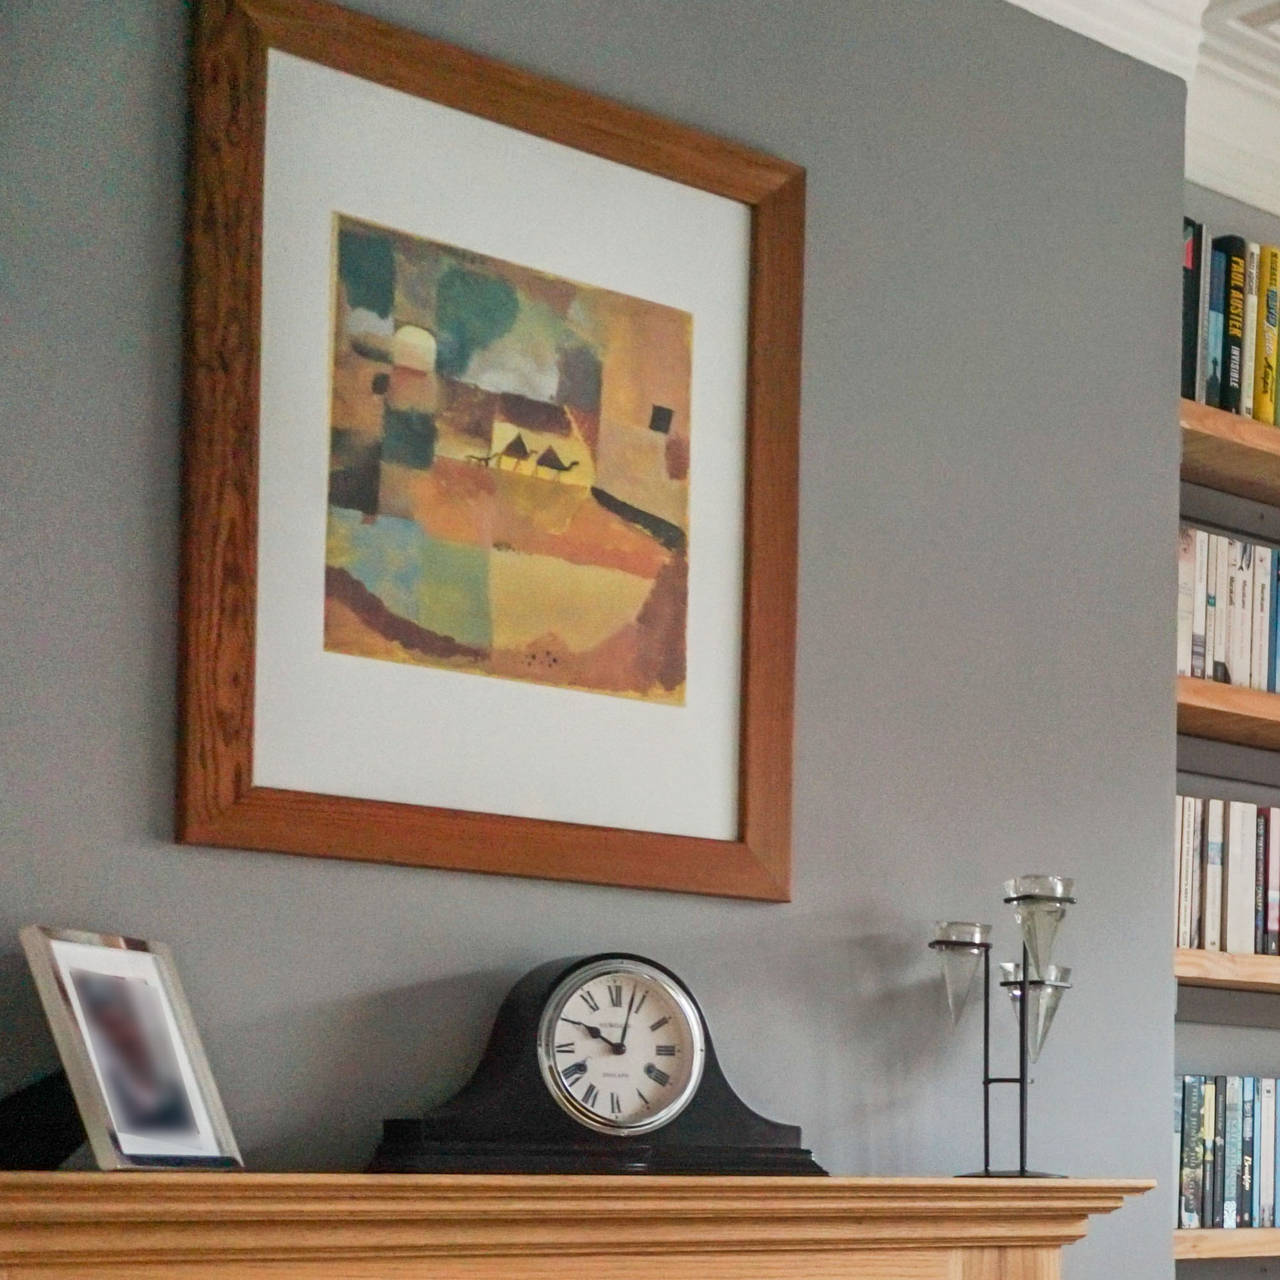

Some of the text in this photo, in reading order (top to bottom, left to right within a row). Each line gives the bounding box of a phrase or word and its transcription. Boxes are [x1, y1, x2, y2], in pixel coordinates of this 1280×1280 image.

[1229, 256, 1246, 390] PAUL AUSTER INVISIBLE
